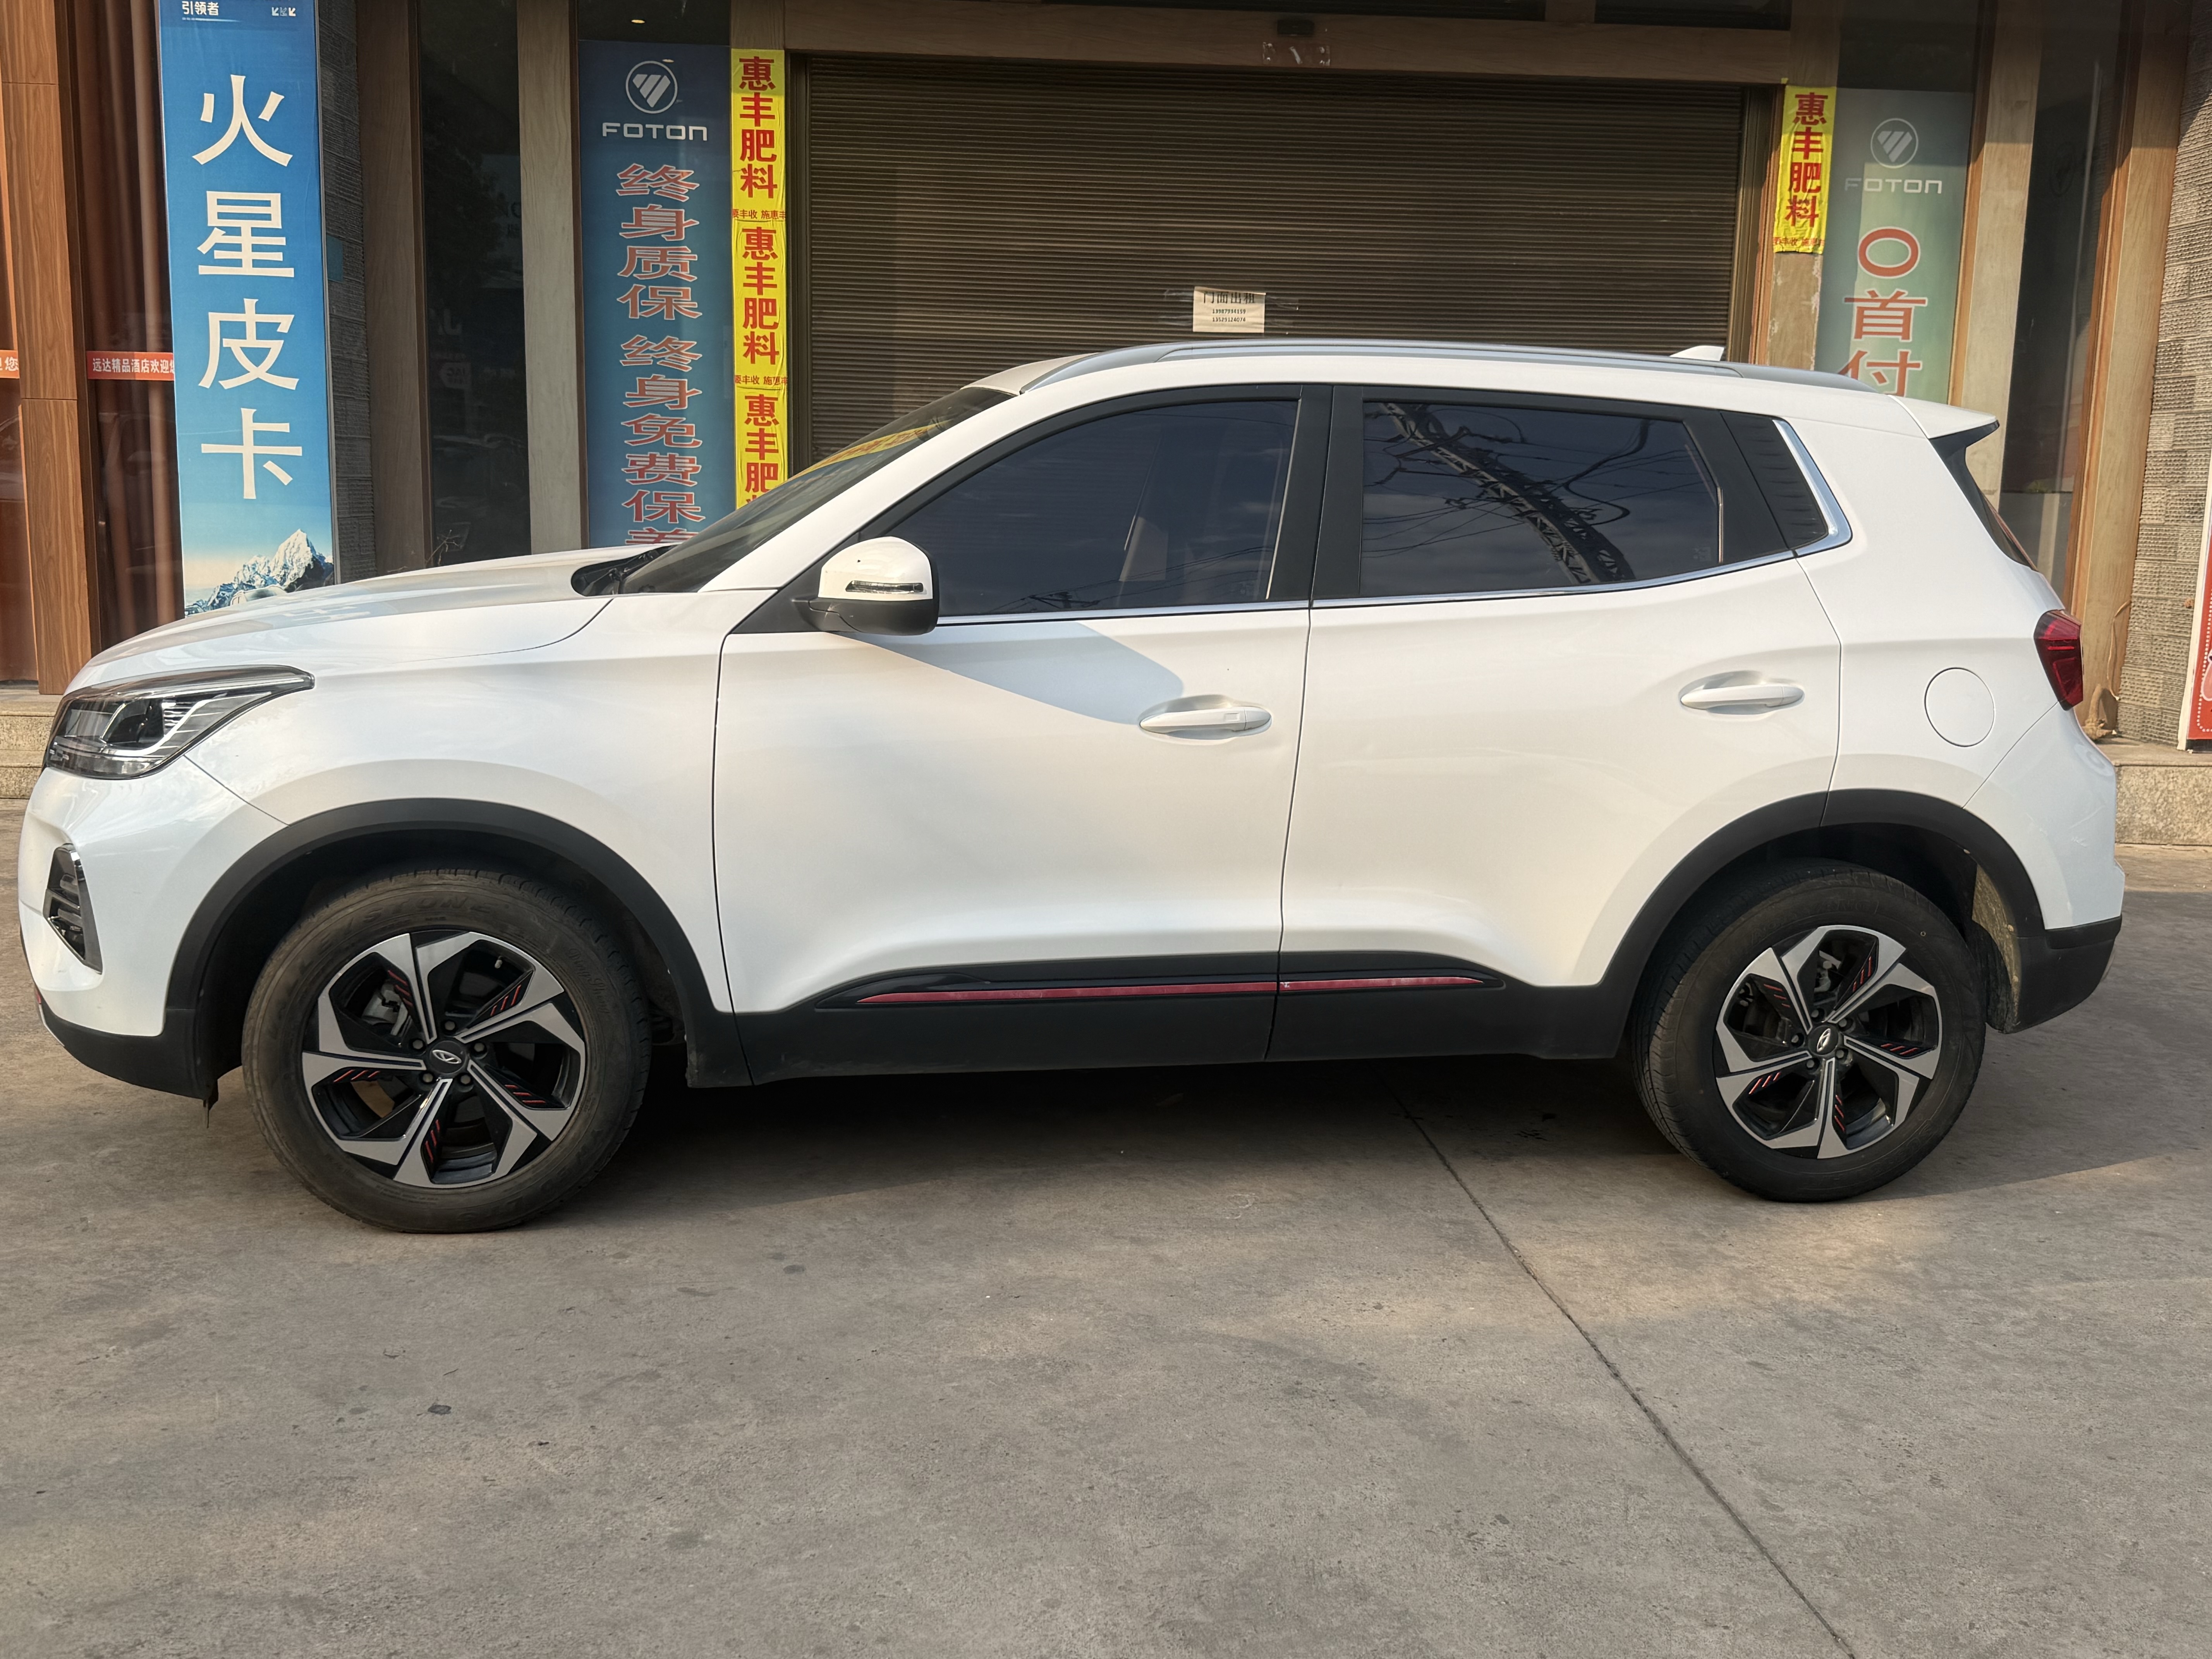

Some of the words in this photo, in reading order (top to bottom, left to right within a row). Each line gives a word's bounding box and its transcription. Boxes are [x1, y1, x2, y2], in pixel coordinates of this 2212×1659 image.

[182, 1, 219, 16] 引领者
[602, 122, 708, 141] FOTON
[739, 56, 778, 199] 惠丰肥料
[1784, 92, 1828, 227] 惠丰肥料
[1844, 177, 1942, 194] FOTON
[192, 74, 302, 499] 火星皮卡
[616, 163, 702, 320] 终身质保
[742, 227, 780, 365] 惠丰肥料
[0, 356, 19, 371] 您
[744, 394, 780, 503] 惠丰肥
